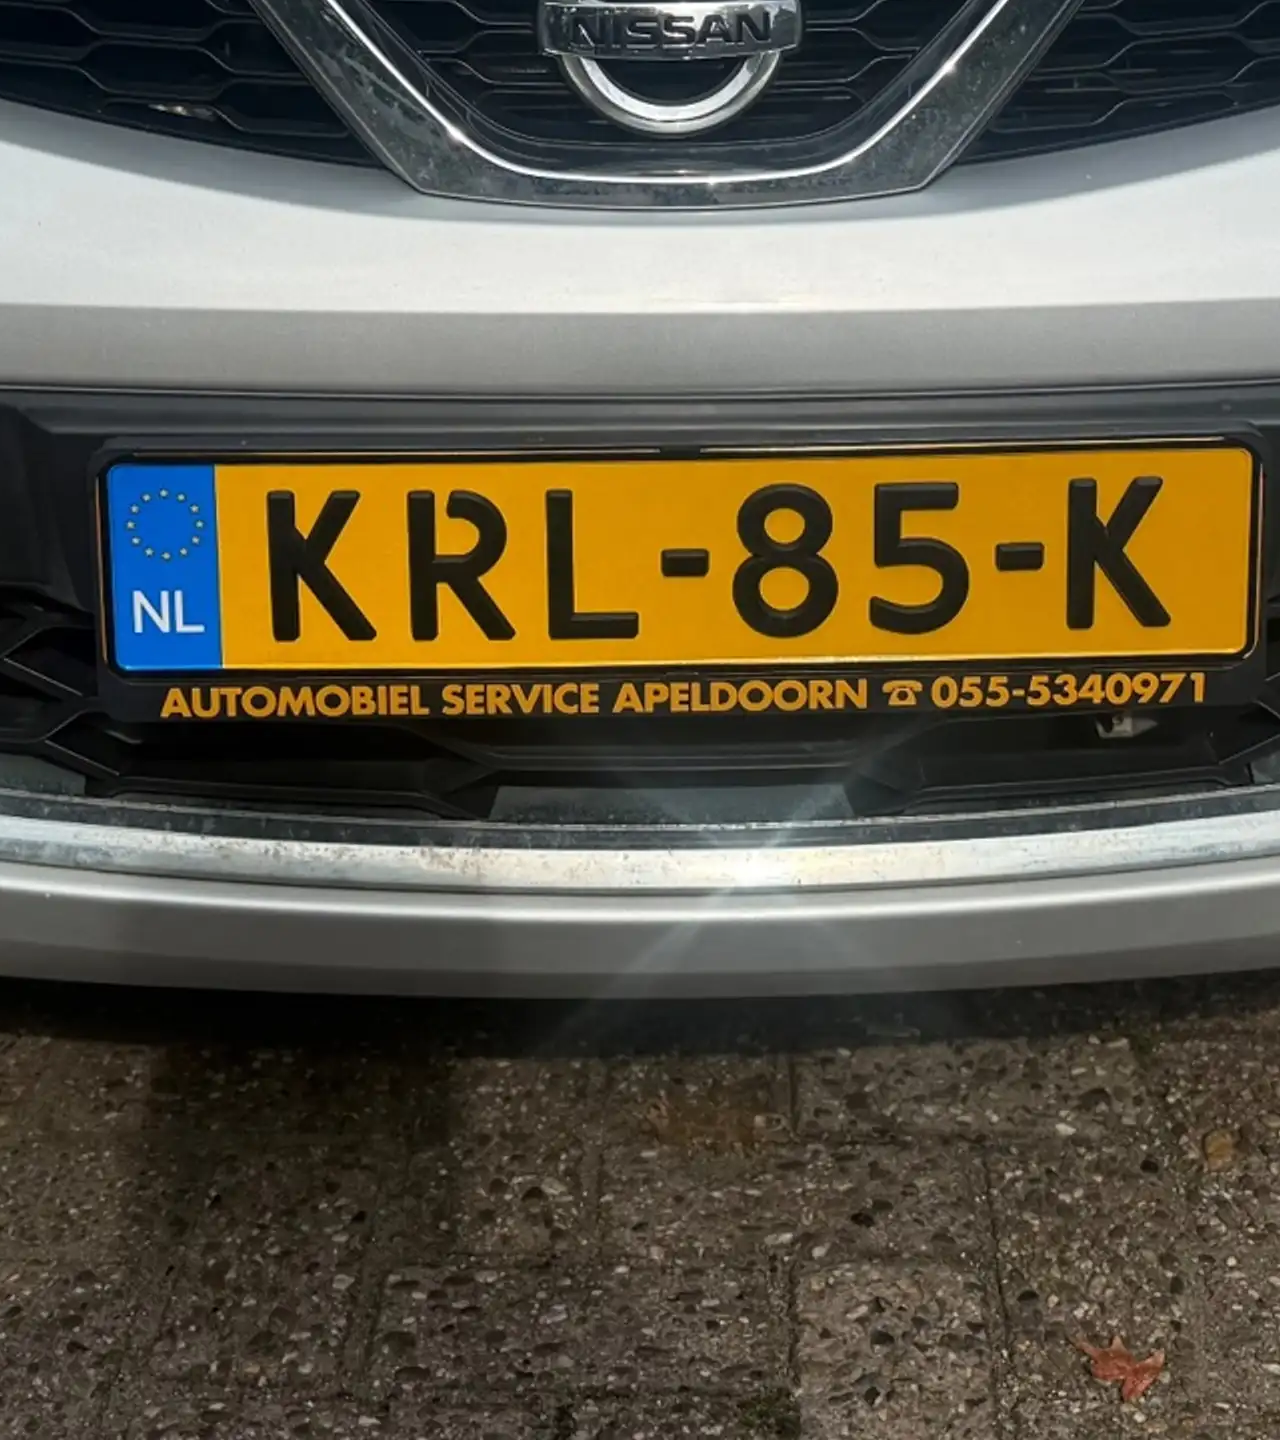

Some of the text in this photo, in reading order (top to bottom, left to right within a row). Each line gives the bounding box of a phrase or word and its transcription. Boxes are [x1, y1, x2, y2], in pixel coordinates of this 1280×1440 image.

[570, 12, 772, 48] NISSAN
[266, 476, 1172, 641] KRL-85-K
[132, 590, 204, 633] NL
[160, 672, 1206, 718] AUTOMOBIEL SERVICE APELDOORN 055-5340971
